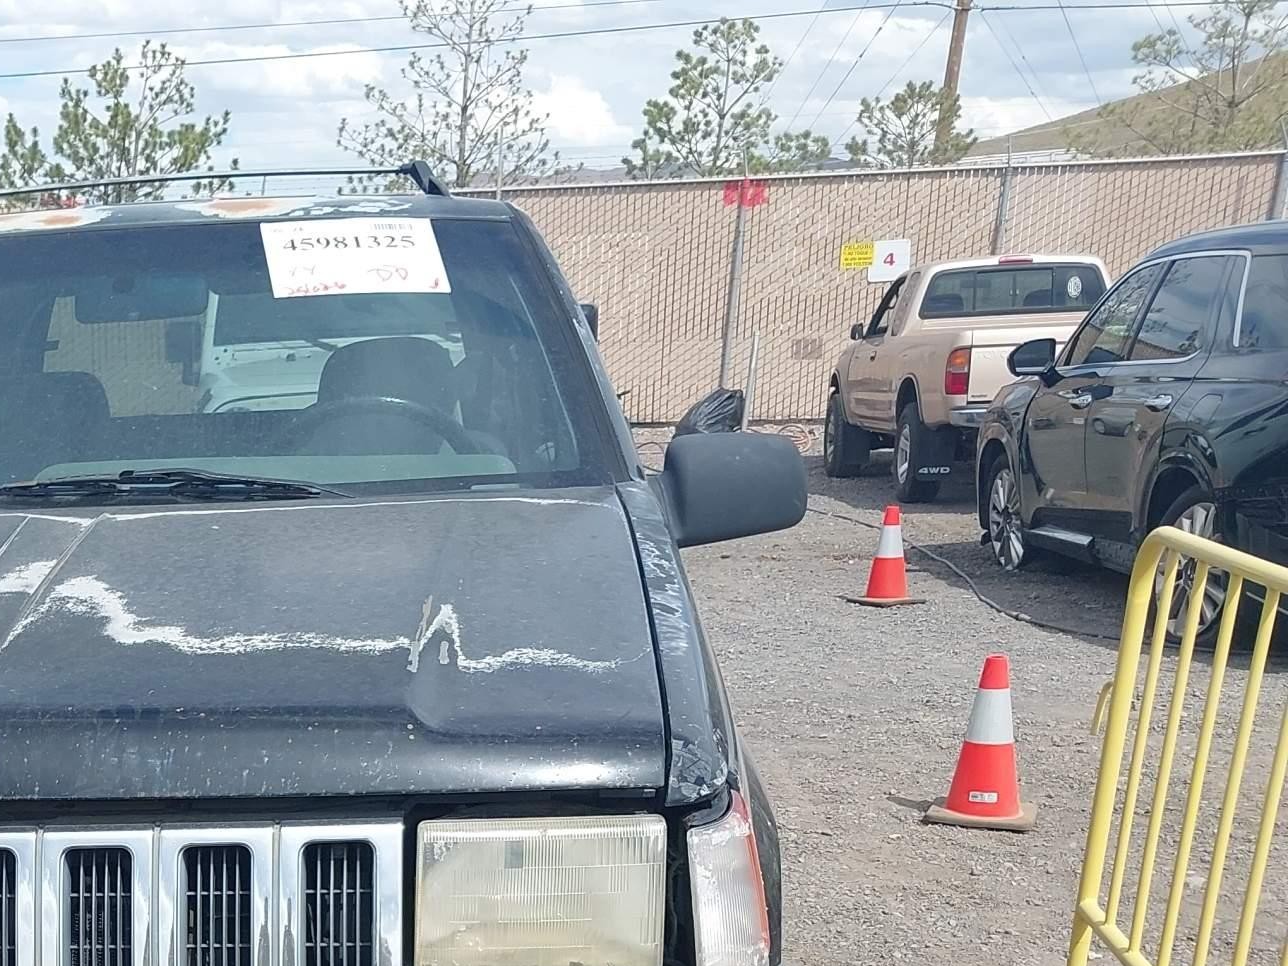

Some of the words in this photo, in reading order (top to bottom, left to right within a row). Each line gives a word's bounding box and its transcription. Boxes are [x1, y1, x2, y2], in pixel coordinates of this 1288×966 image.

[283, 234, 416, 252] 45981325
[883, 252, 896, 266] 4
[918, 466, 951, 474] 4WD
